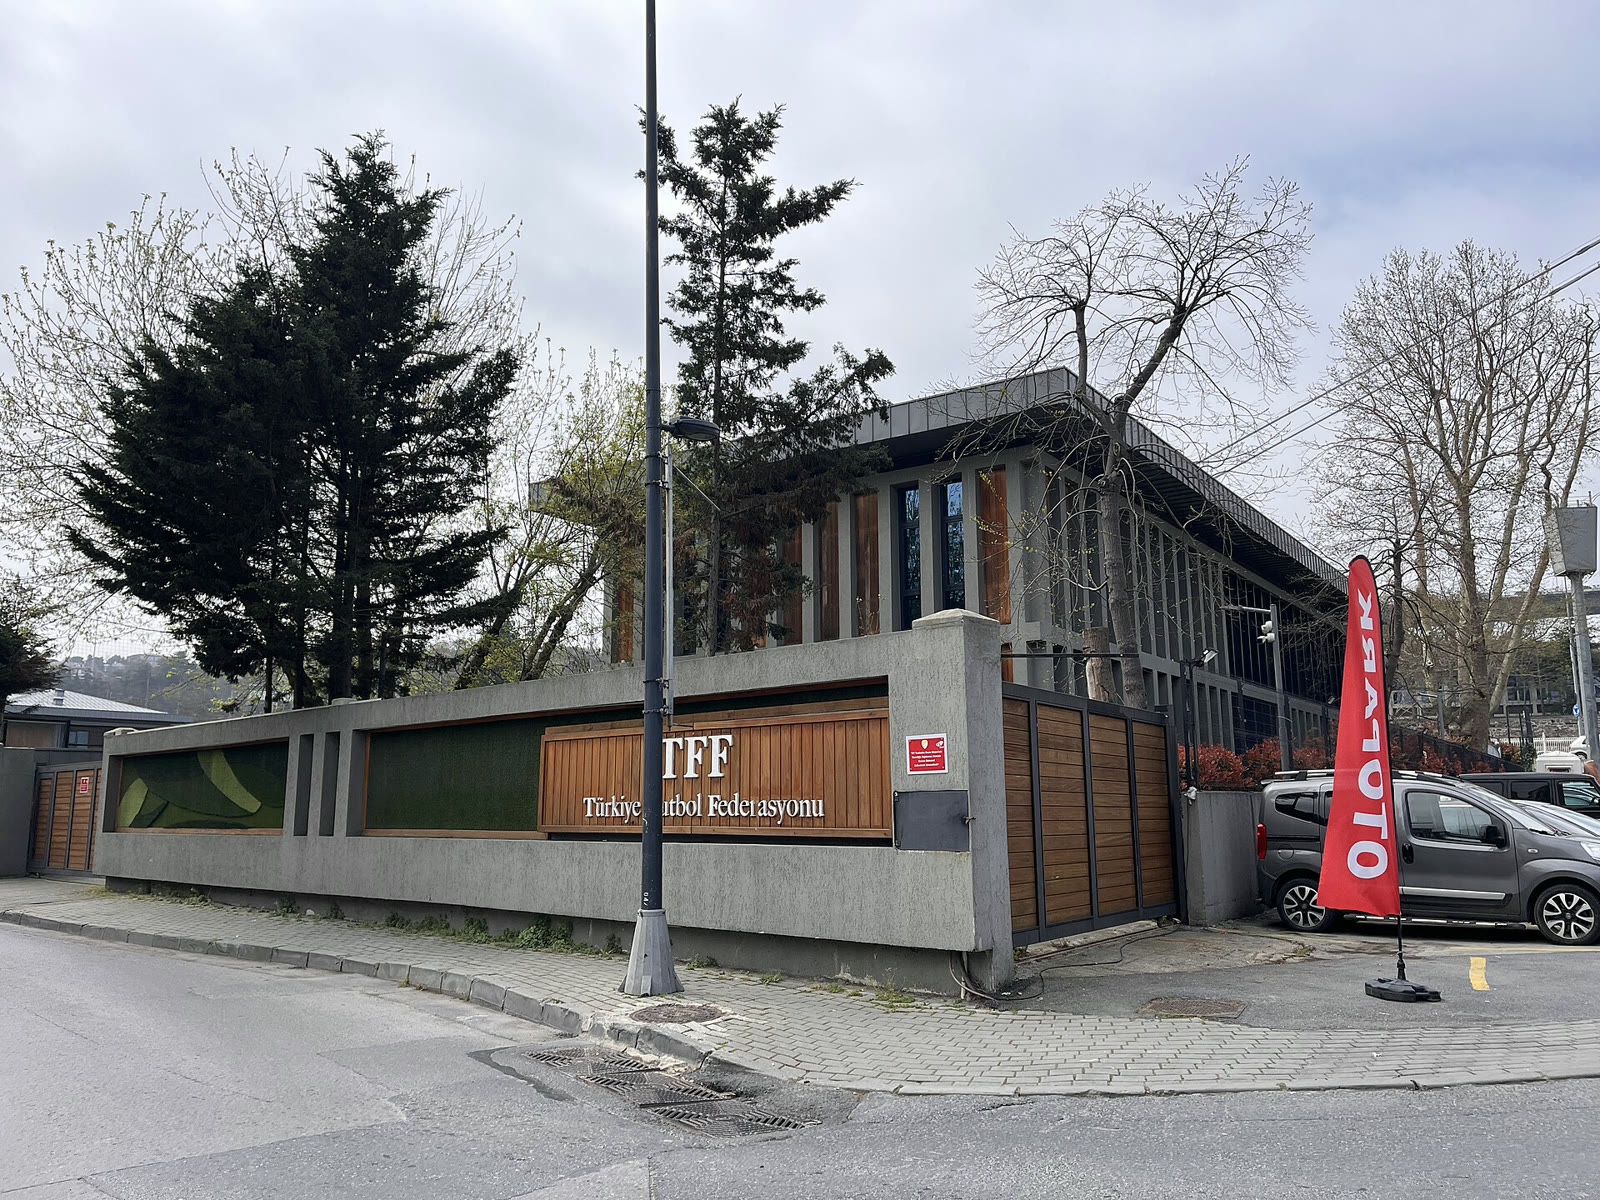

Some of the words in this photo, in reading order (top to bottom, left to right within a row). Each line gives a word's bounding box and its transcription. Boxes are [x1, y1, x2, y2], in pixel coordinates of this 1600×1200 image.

[662, 734, 733, 779] TFF
[583, 795, 642, 824] Türkiye
[662, 792, 703, 817] utbol
